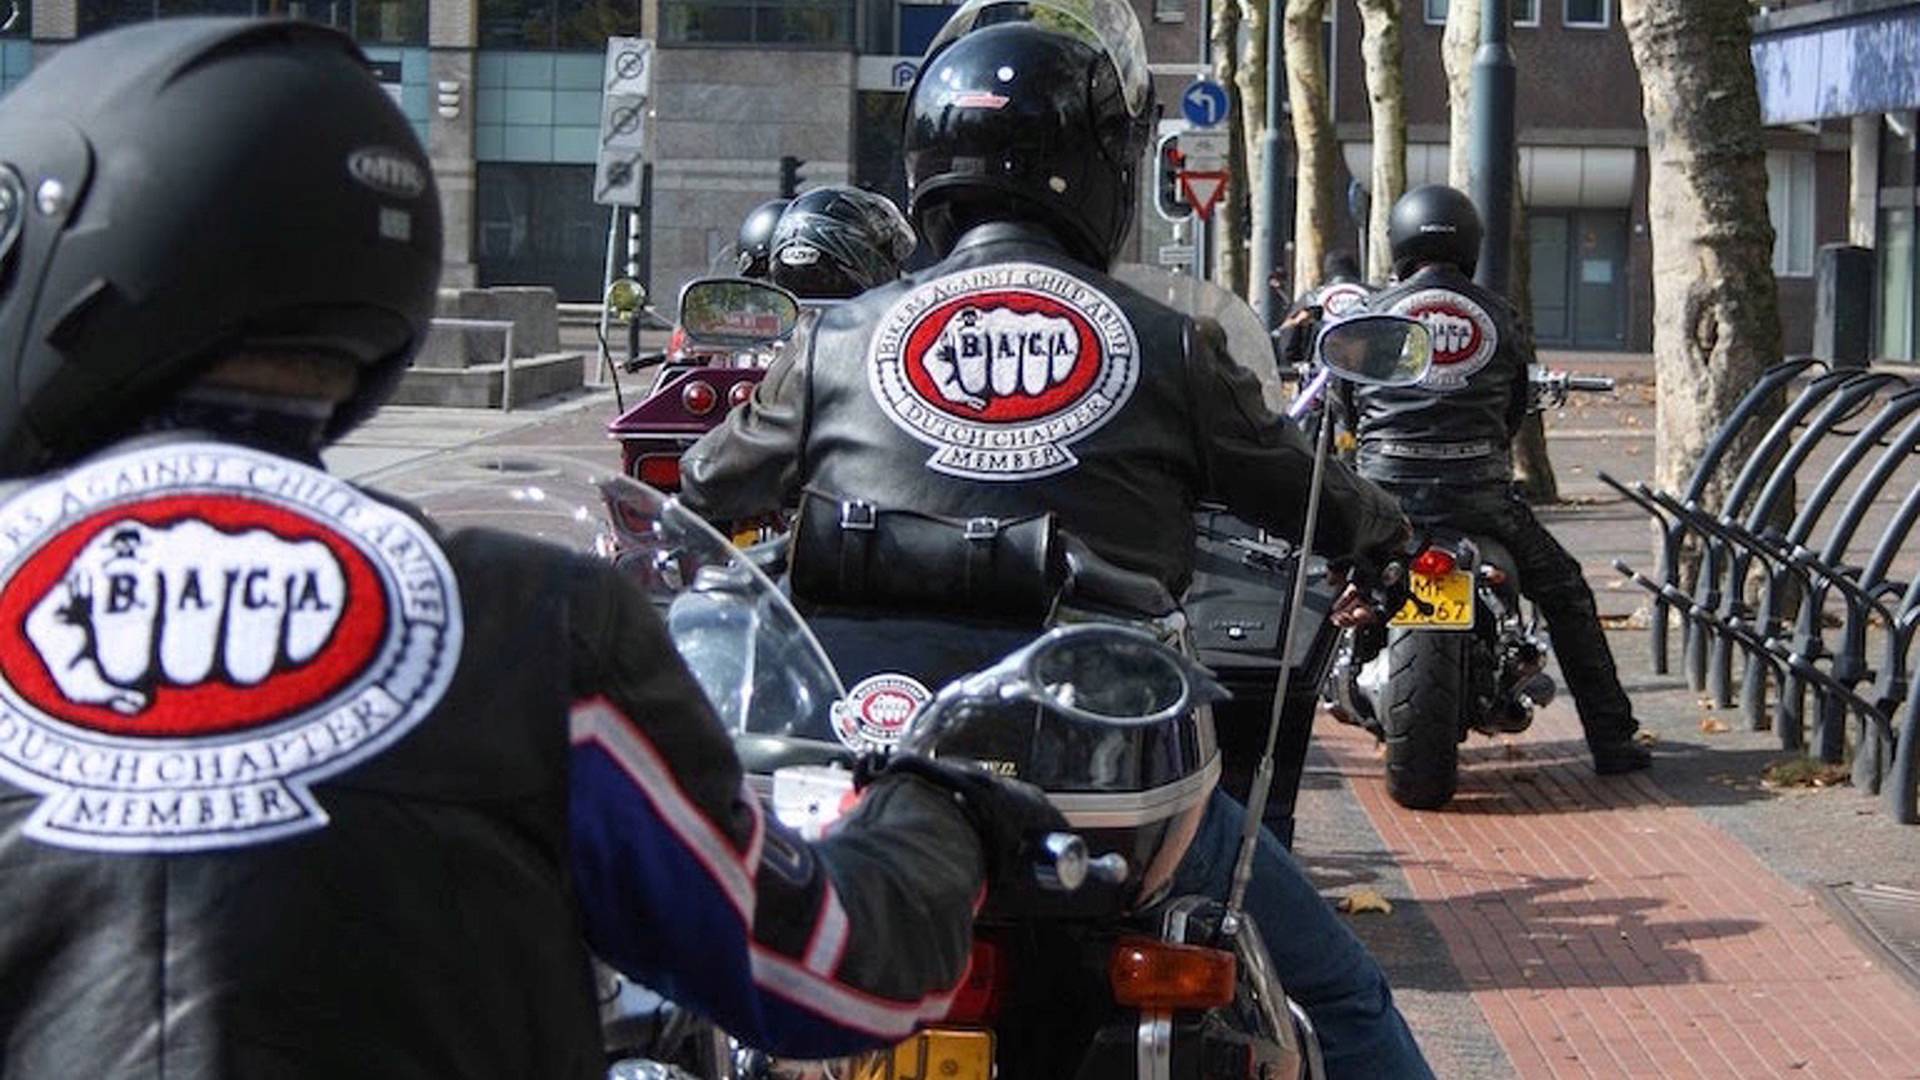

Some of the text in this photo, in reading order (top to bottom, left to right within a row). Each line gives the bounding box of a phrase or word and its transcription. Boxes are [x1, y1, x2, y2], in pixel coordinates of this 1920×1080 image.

[879, 269, 1127, 354] BIKERS AGAINST CHILD ABUSE
[906, 400, 1105, 445] DUTCH CHAPTER
[951, 448, 1060, 469] MEMBER
[59, 454, 224, 518] AGAINST
[247, 462, 362, 519] CHILD
[0, 698, 391, 784] DUTCH CHAPTER
[72, 787, 290, 826] MEMBER
